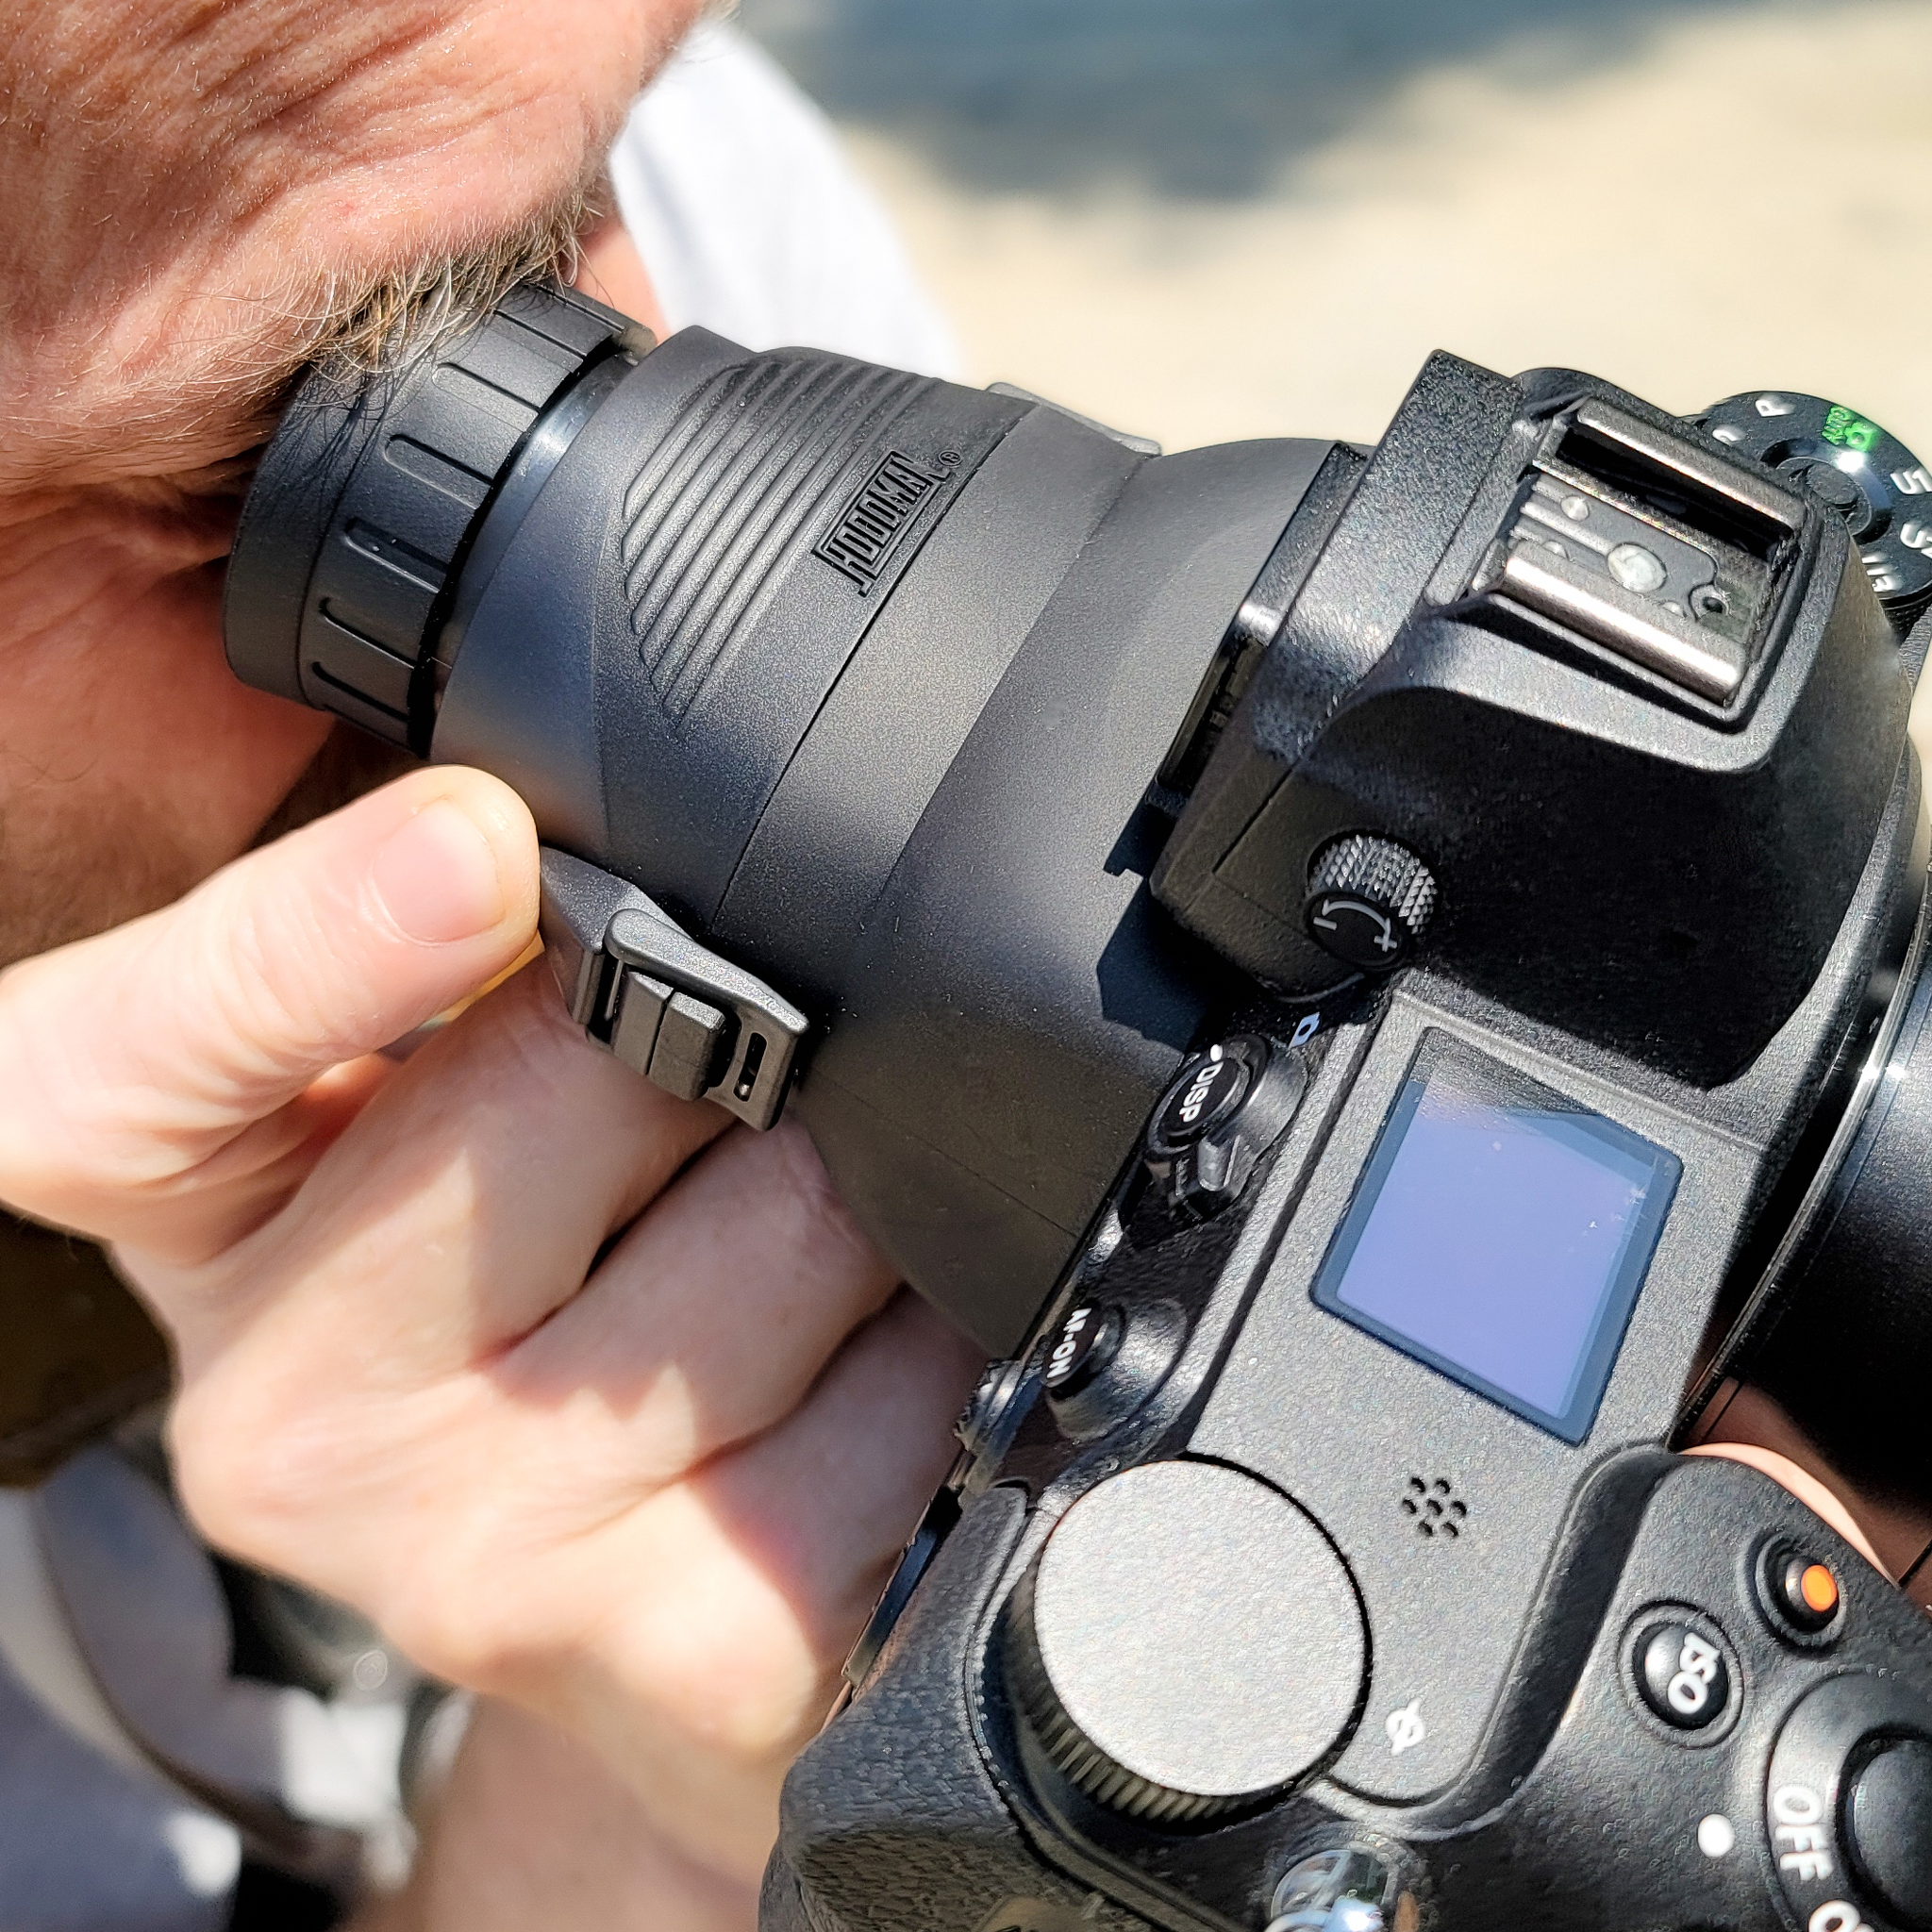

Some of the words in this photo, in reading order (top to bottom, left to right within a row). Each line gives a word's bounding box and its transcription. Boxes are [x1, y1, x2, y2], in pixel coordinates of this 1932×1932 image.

[1179, 1061, 1224, 1123] DISP
[1667, 1632, 1720, 1714] ISO
[1773, 1786, 1833, 1881] OFF
